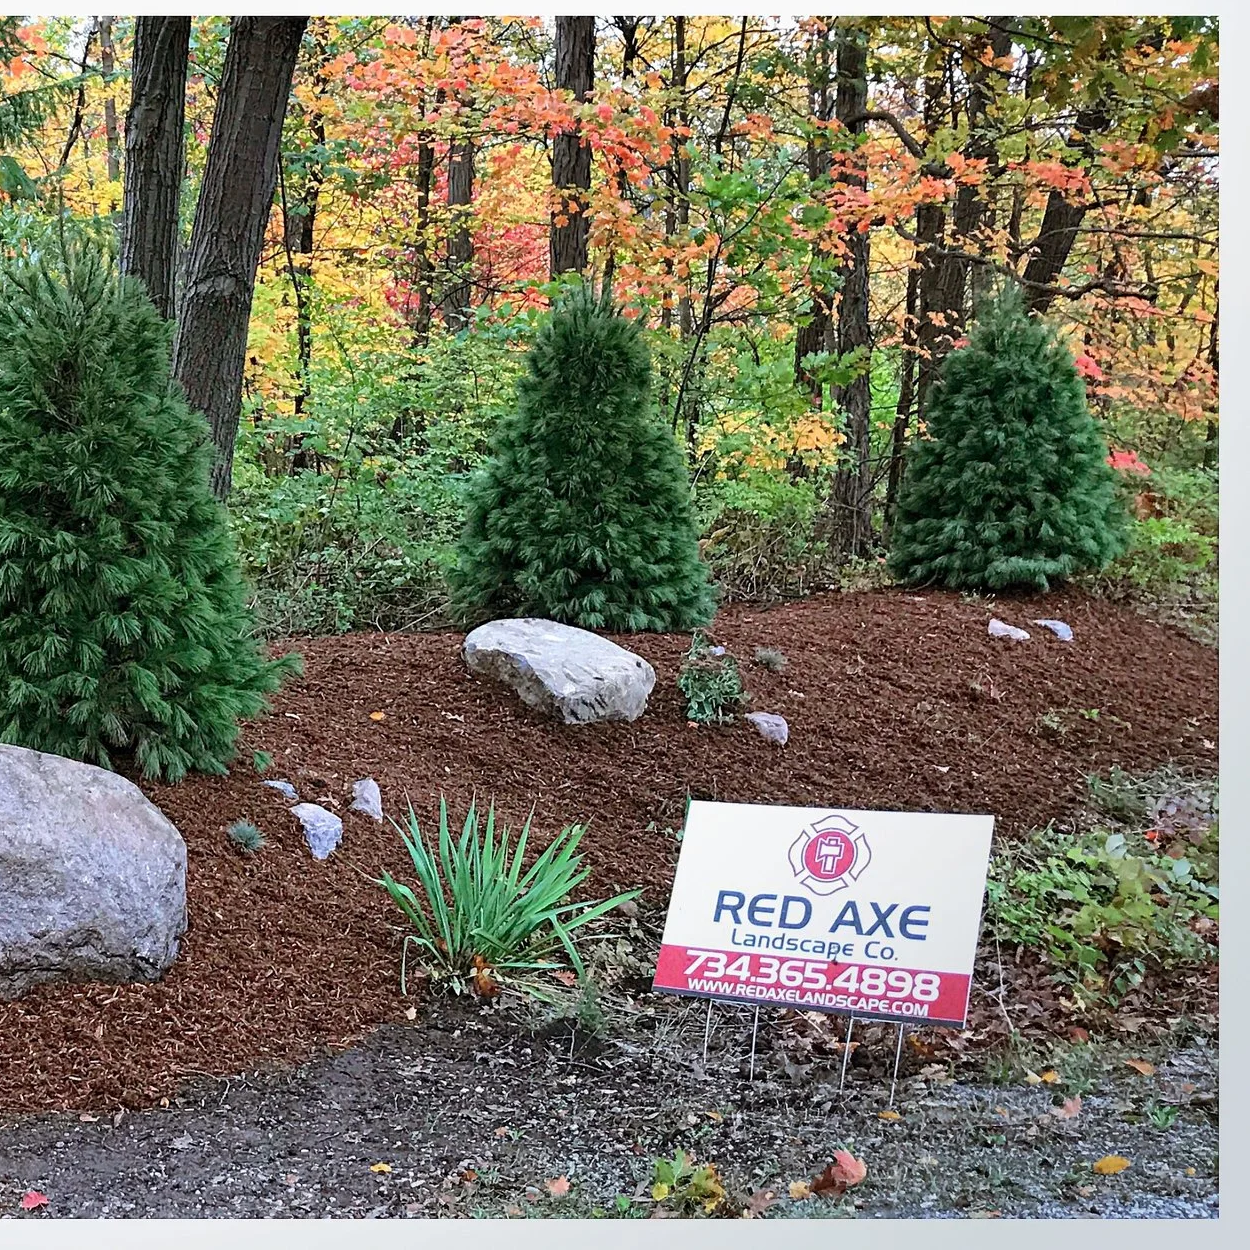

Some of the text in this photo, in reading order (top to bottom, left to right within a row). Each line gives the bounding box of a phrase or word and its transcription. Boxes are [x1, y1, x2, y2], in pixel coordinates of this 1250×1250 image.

[713, 890, 931, 941] RED AXE
[731, 928, 898, 961] Landscape Co.
[683, 950, 941, 1001] 734.365.4898
[687, 977, 929, 1017] WWW.REDAXELANDSCAPE.COM
